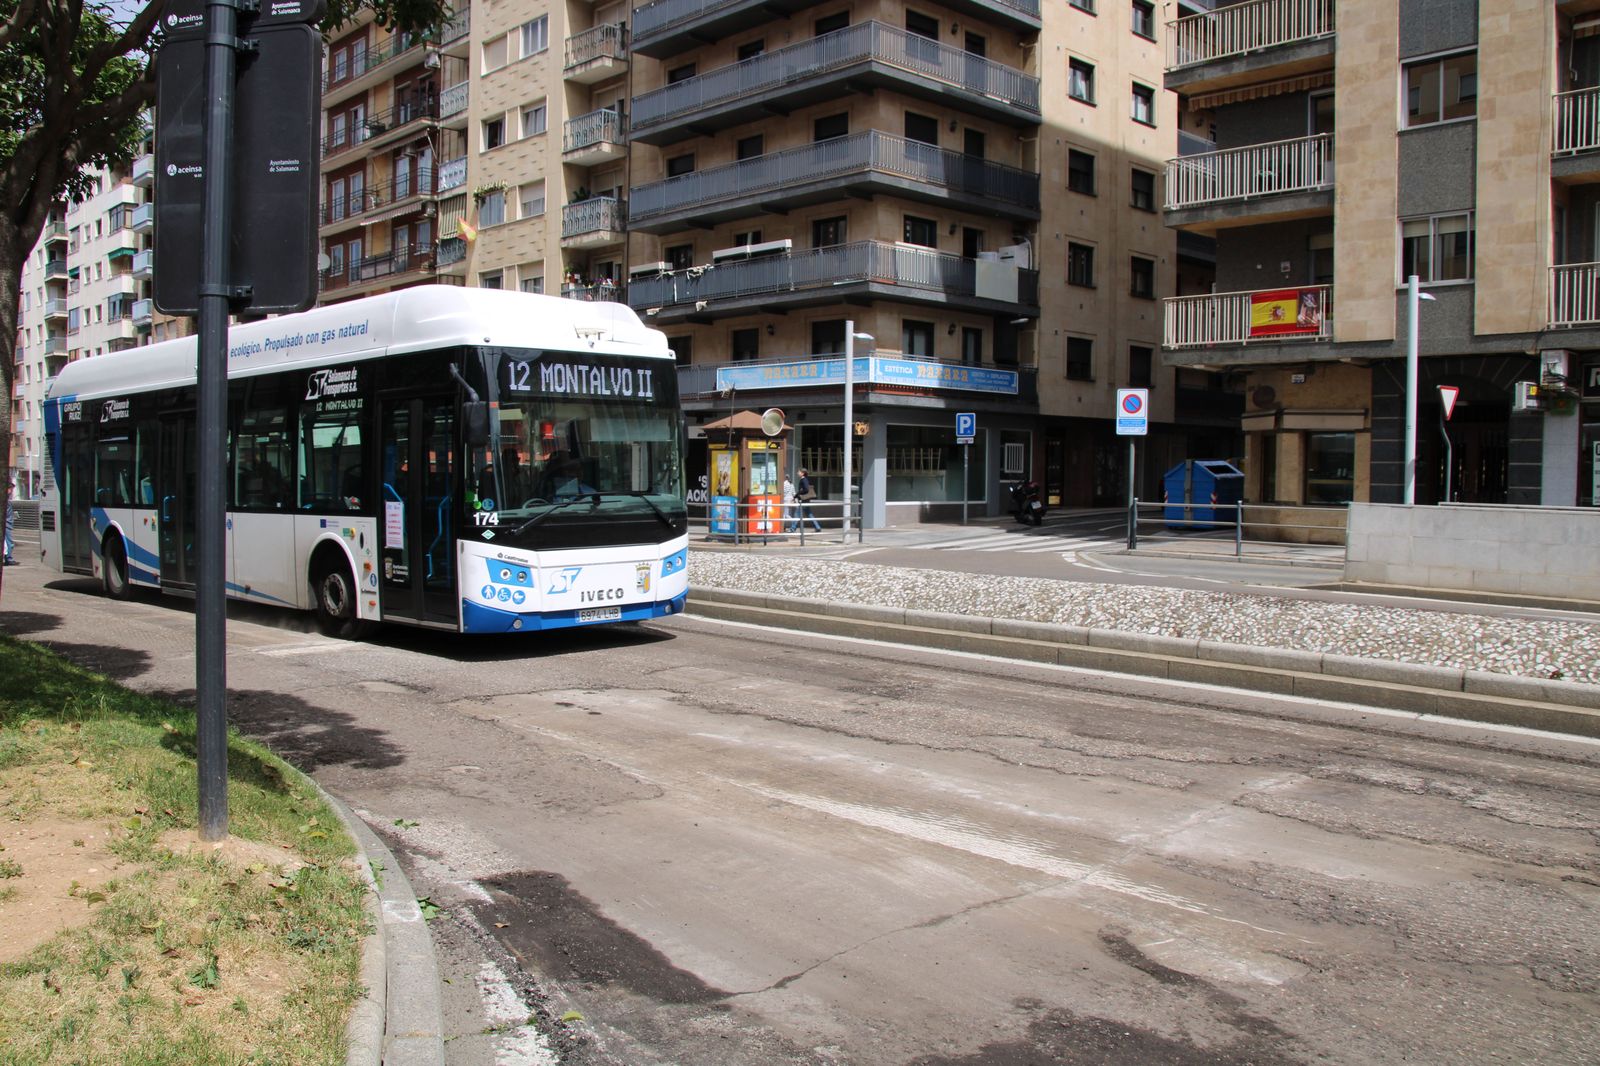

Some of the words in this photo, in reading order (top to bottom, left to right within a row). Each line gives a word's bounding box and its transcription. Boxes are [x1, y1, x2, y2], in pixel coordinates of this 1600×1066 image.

[178, 14, 203, 23] aceinsa
[177, 165, 202, 174] aceinsa
[269, 159, 300, 167] Ayuntamiento
[230, 341, 262, 357] ecológico.
[264, 332, 304, 352] Propulsado
[305, 331, 320, 345] con
[321, 329, 336, 344] gas
[338, 319, 369, 338] natural
[328, 369, 351, 383] Salamanca
[351, 366, 357, 380] de
[508, 361, 531, 391] 12
[540, 362, 633, 396] MONTALVO
[638, 369, 653, 397] II
[323, 382, 349, 397] Transportes
[64, 403, 81, 412] GRUPO
[960, 416, 971, 434] P
[473, 512, 499, 526] 174
[580, 587, 624, 602] IVECO
[581, 609, 601, 621] 6974
